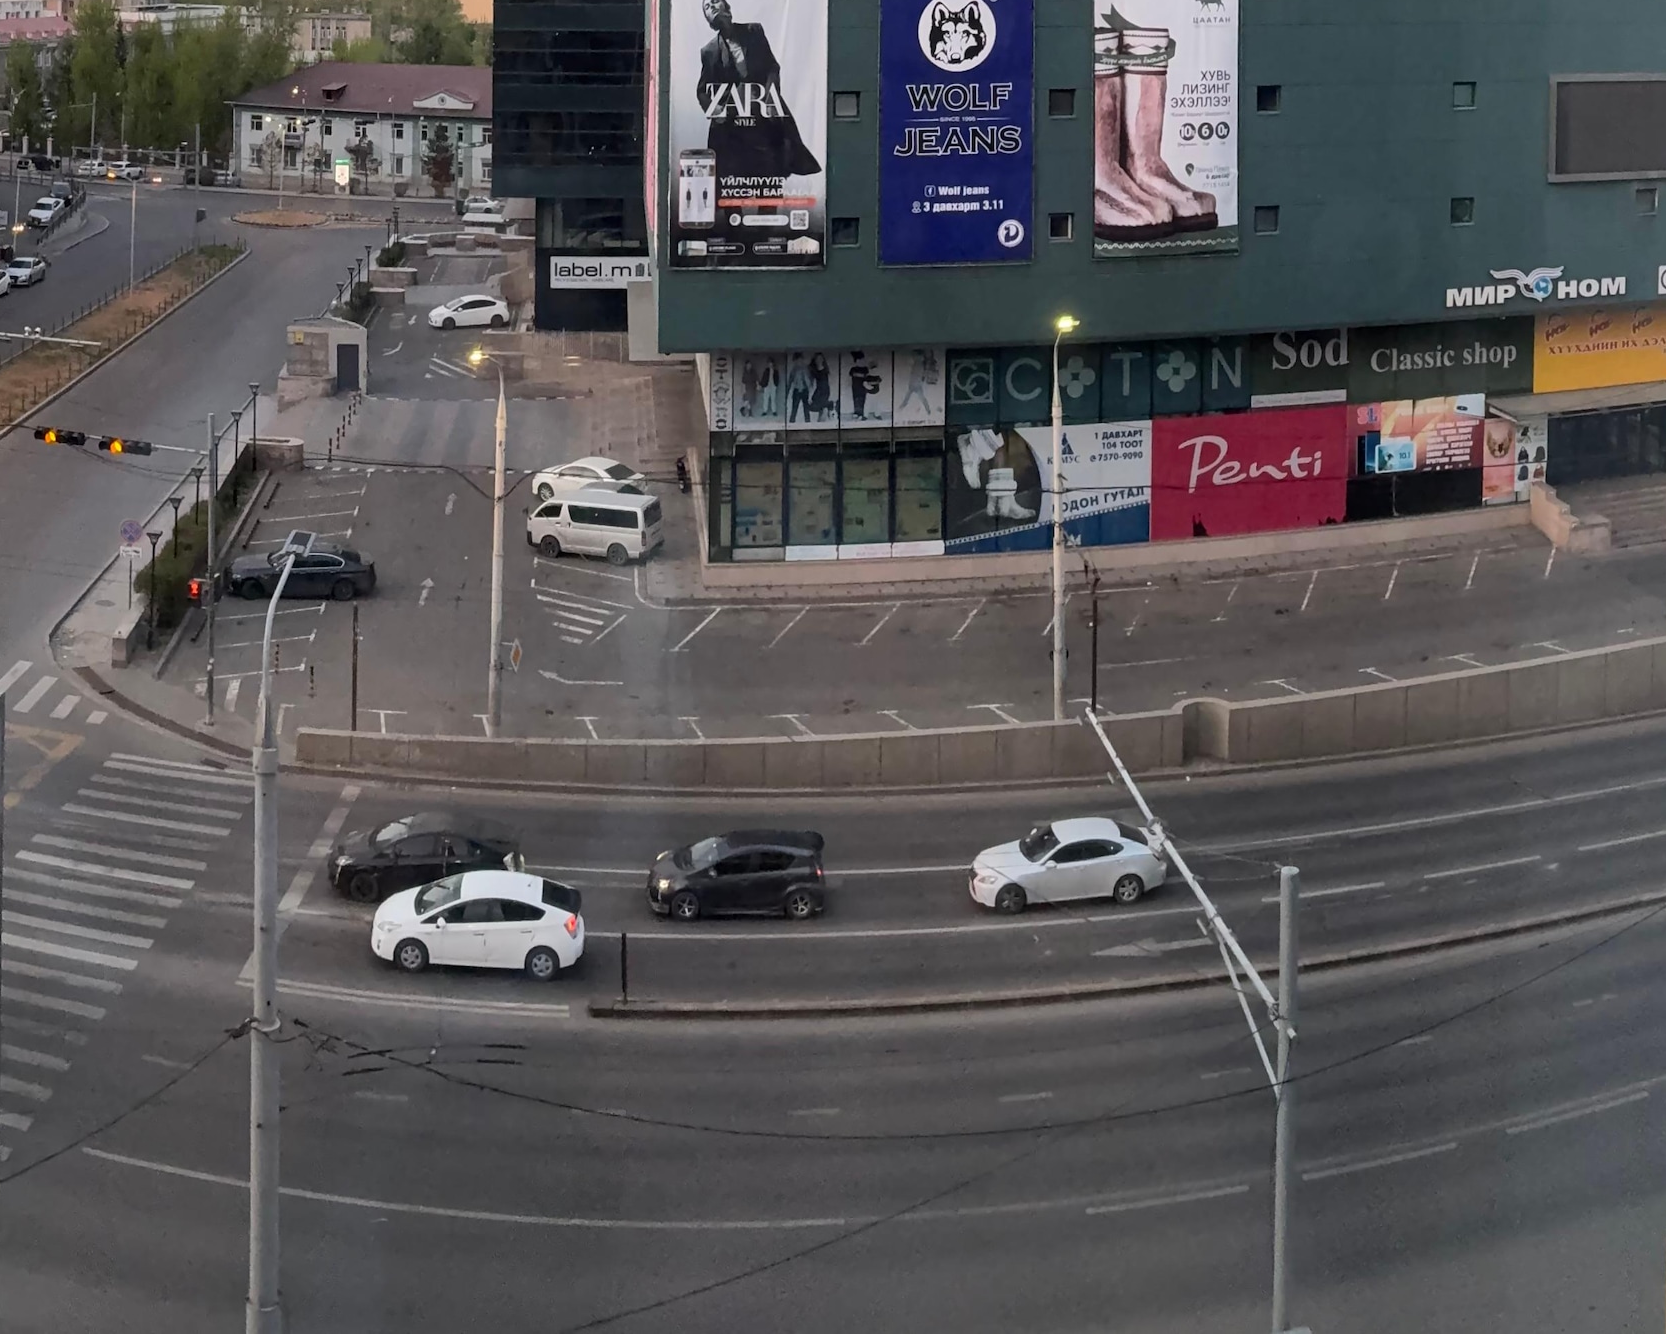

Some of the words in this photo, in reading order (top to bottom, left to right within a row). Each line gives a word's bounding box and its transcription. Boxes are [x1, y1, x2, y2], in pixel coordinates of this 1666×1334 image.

[1201, 70, 1231, 82] ХУВЬ
[1181, 83, 1231, 95] ЛИЗИНГ
[704, 82, 790, 119] ZARA
[906, 82, 1012, 111] WOLF
[734, 118, 756, 127] STYLE
[894, 125, 1022, 156] JEANS
[938, 186, 962, 196] Wolf
[923, 202, 931, 212] 3
[982, 200, 1004, 211] 3.11
[554, 262, 632, 277] label.m
[1446, 284, 1516, 307] МИР
[1557, 276, 1627, 299] НОМ
[1272, 327, 1350, 371] Sod
[1370, 345, 1455, 373] Classic
[1462, 342, 1517, 368] shop
[1101, 430, 1143, 440] ДАВХАРТ
[1119, 440, 1143, 449] ТООТ
[1047, 455, 1081, 464] КМУС
[1098, 451, 1144, 462] 7570-9090
[1178, 435, 1322, 494] Penti
[1053, 495, 1099, 514] ОДОН
[1104, 486, 1145, 504] ГУТАЛ
